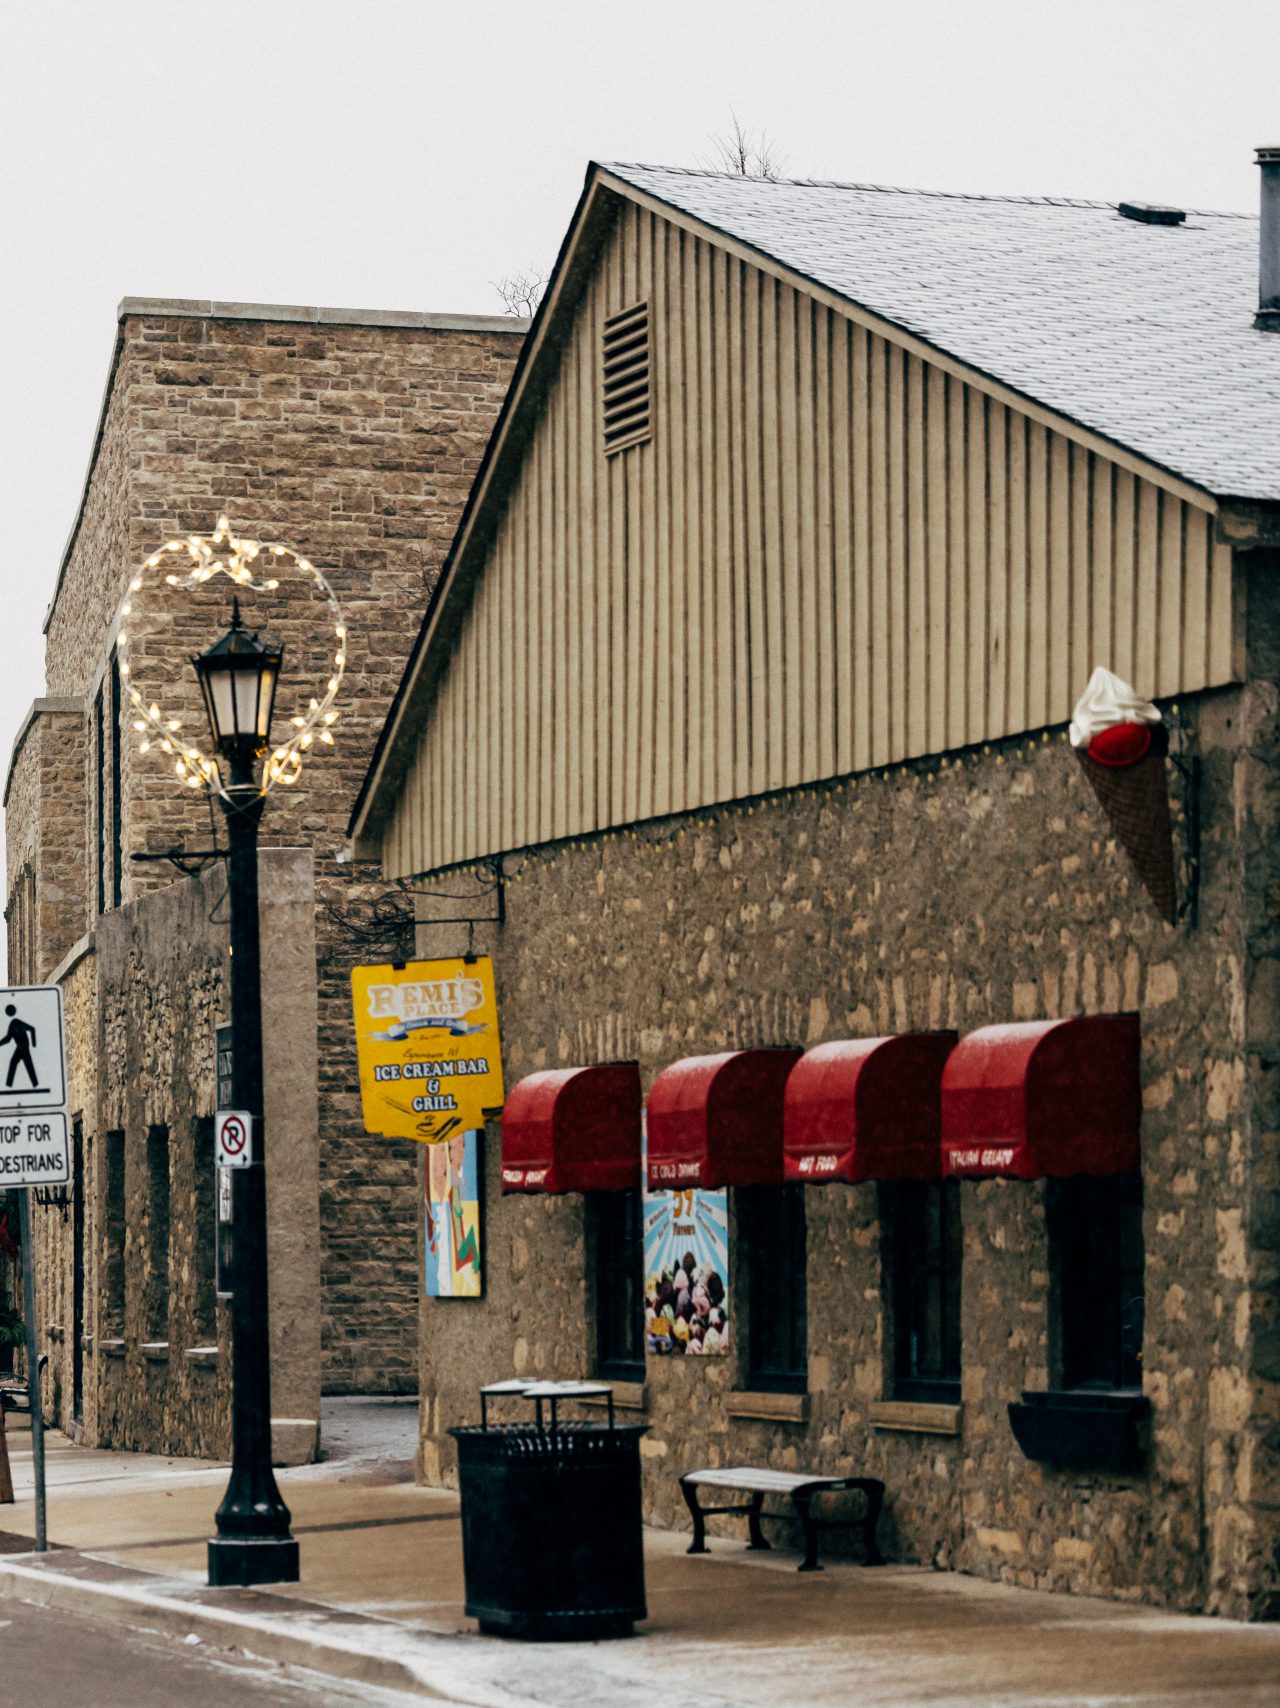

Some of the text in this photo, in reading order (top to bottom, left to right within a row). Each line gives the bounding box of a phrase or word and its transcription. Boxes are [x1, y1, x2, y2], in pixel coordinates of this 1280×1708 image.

[369, 970, 484, 1015] REMI'S
[405, 1002, 460, 1017] PLACE
[375, 1058, 489, 1081] ICE CREAM BAR
[426, 1079, 440, 1095] &
[412, 1095, 457, 1111] GRILL
[27, 1123, 51, 1143] FOR
